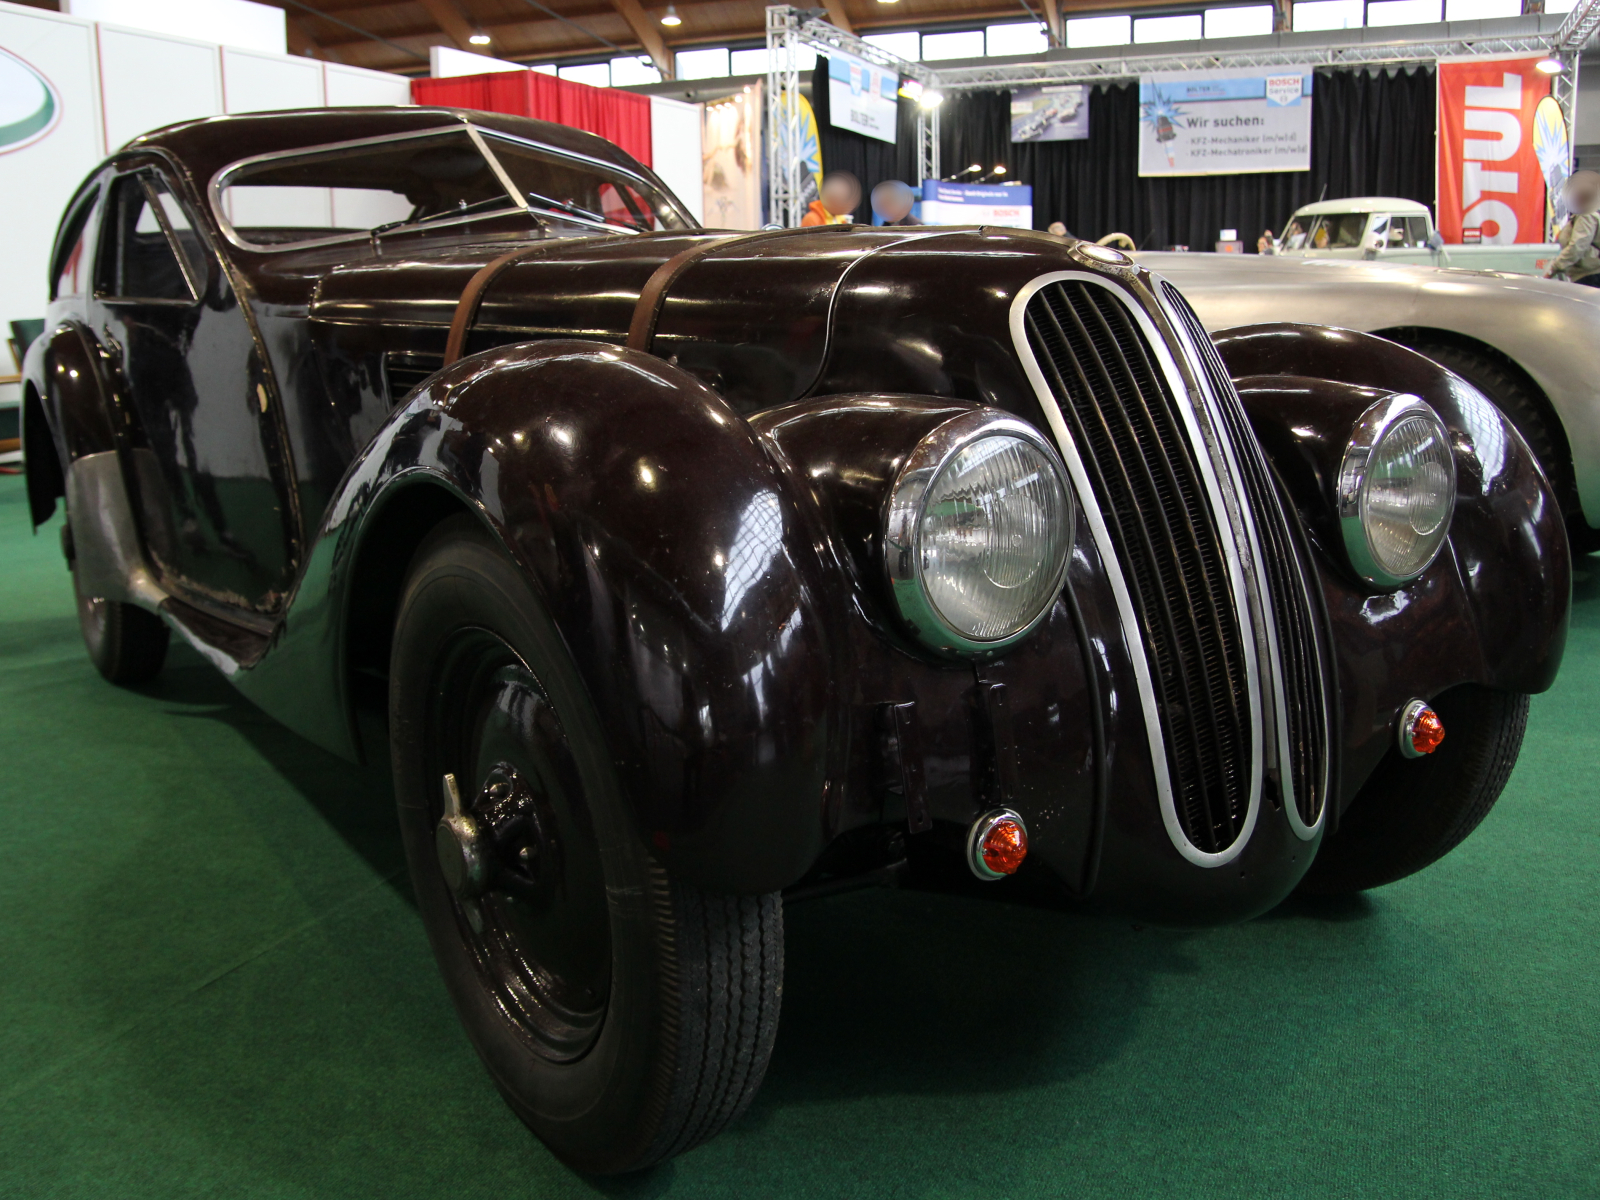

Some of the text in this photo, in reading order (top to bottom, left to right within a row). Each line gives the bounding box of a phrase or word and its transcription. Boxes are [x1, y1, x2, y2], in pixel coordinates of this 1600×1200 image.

[1269, 78, 1300, 86] BOSCH
[1269, 87, 1299, 95] Service
[1187, 115, 1265, 128] Wir suchen:
[1190, 135, 1260, 145] KFZ-Mechaniker
[1190, 146, 1272, 157] KFZ-Mechatroniker
